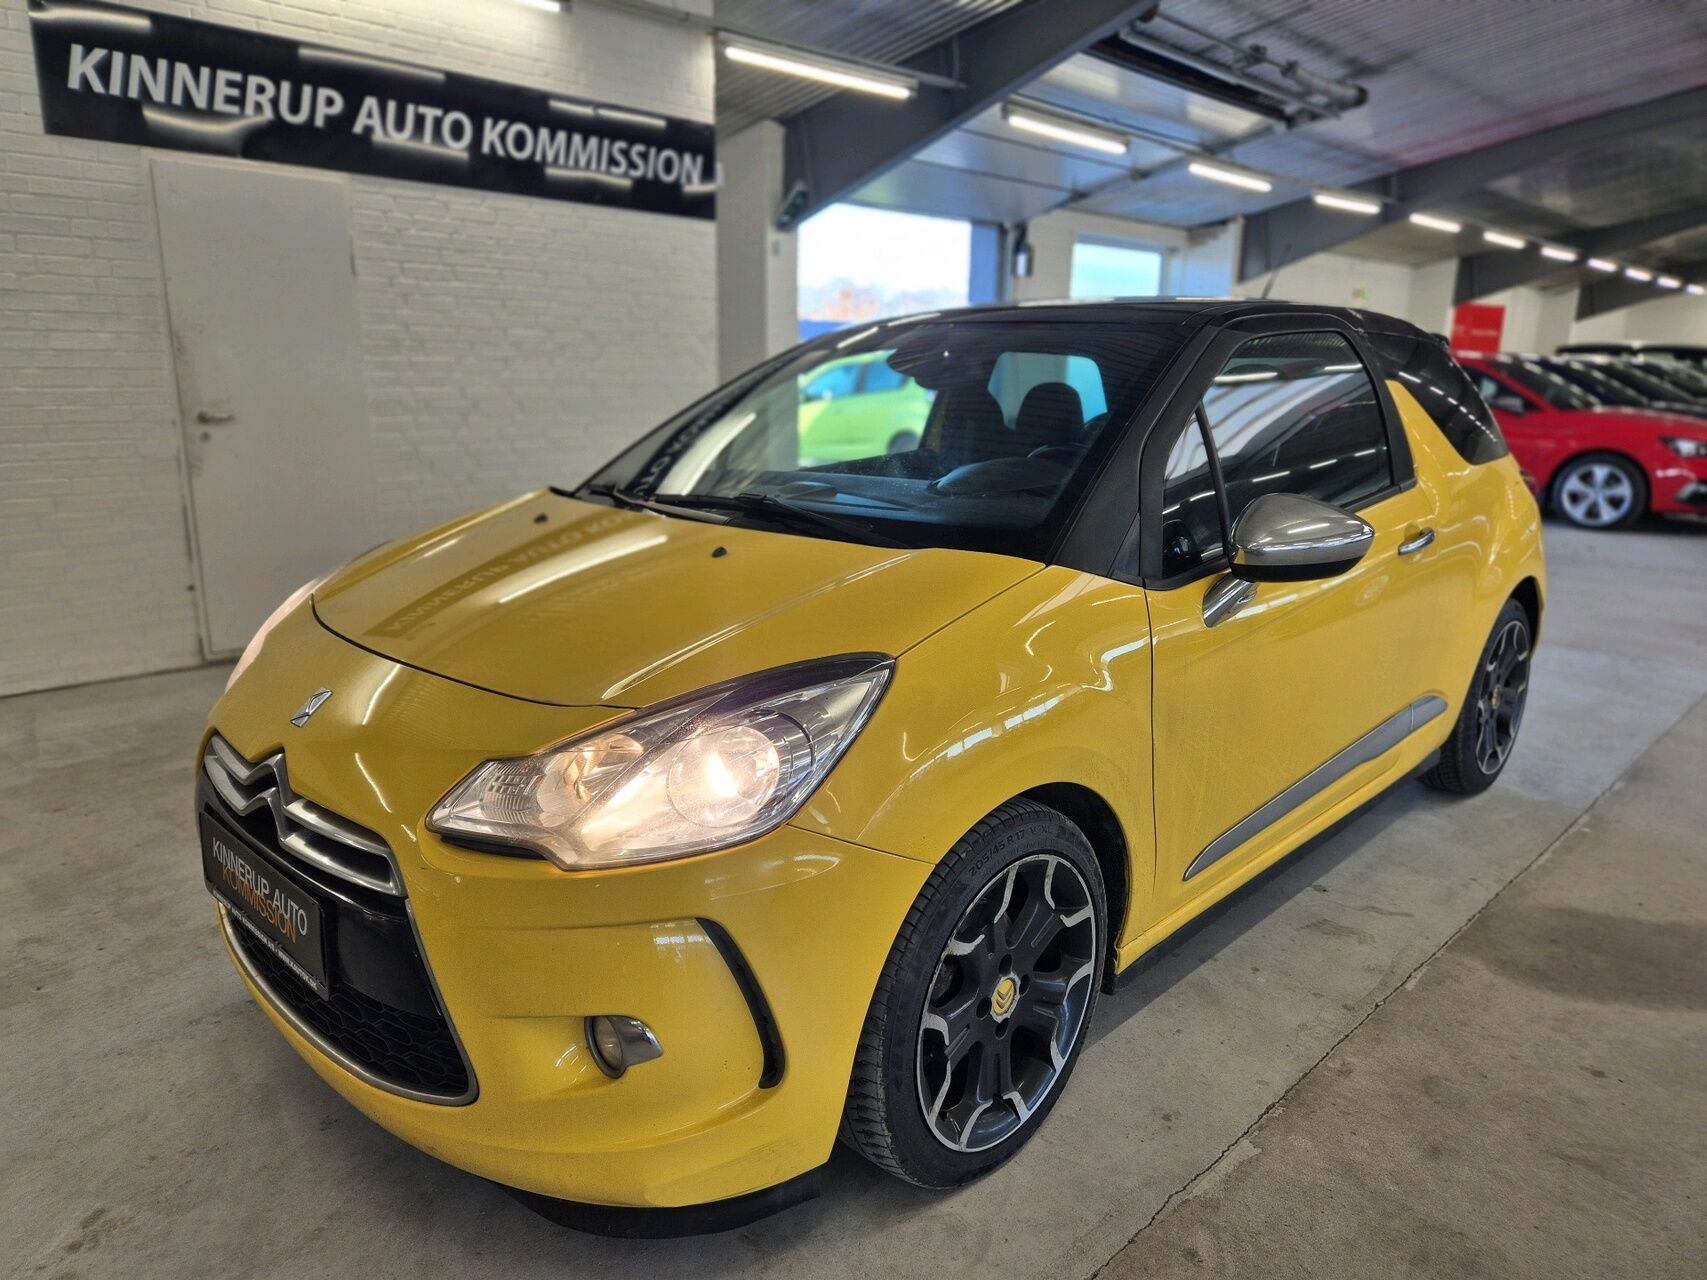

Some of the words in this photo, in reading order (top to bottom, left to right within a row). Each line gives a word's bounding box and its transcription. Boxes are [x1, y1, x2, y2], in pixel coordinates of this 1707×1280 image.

[67, 43, 344, 128] KINNERUP
[352, 96, 473, 150] AUTO
[480, 117, 704, 187] KOMMISSION
[212, 837, 269, 898] KINNERUP
[271, 888, 307, 936] AUTO
[968, 839, 1006, 878] 205/45
[1006, 835, 1015, 845] R
[1015, 829, 1025, 840] 17
[222, 864, 296, 943] KOMMISSION
